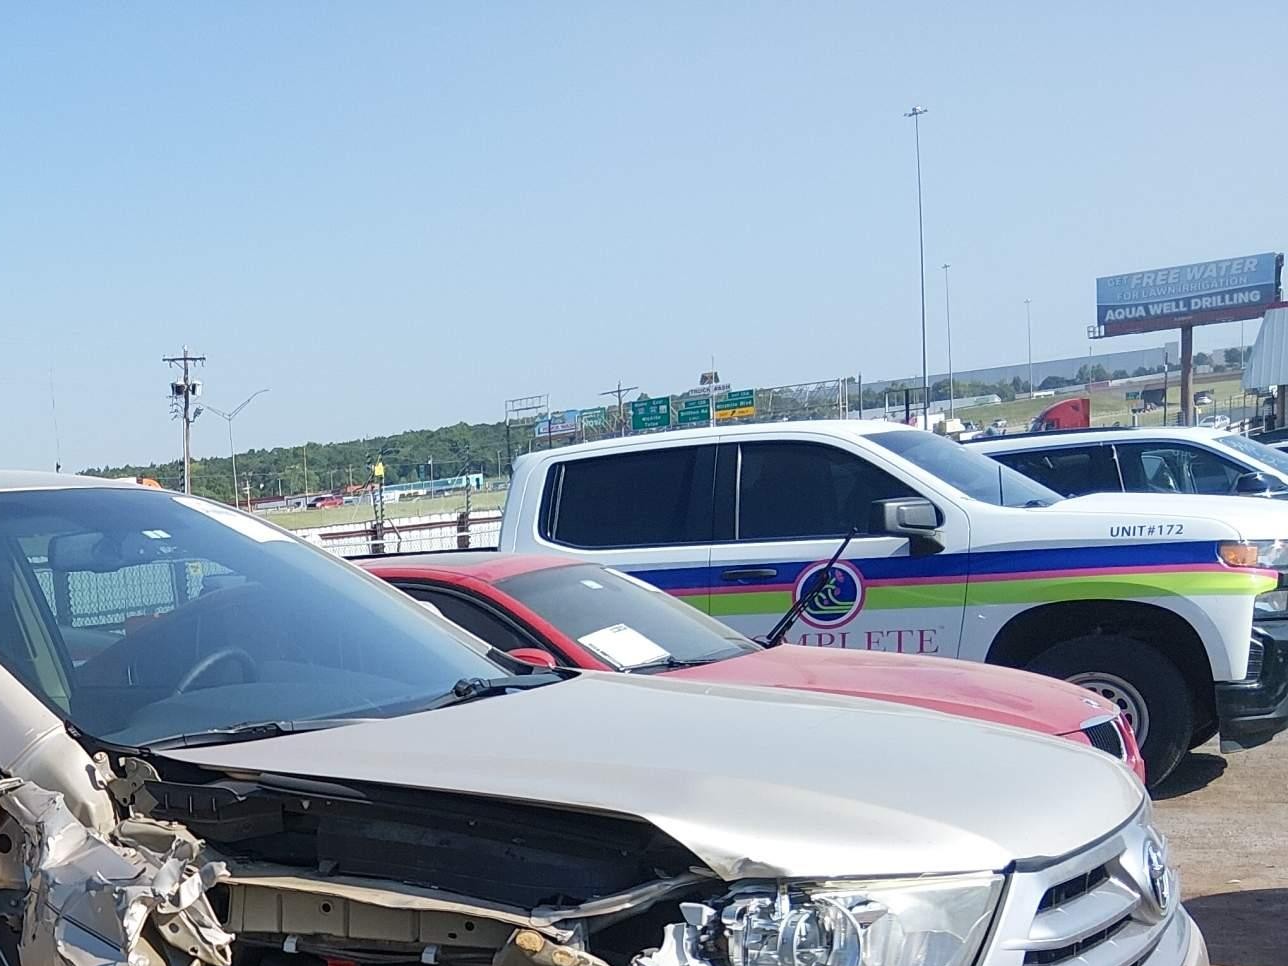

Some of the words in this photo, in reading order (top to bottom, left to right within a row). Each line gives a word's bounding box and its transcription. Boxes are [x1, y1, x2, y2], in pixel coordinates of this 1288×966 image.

[1131, 269, 1180, 288] FREE
[1186, 258, 1258, 281] WATER
[1117, 289, 1139, 301] FOR
[1142, 285, 1175, 298] LAWN
[1177, 276, 1249, 293] IRRIGATION
[1105, 305, 1147, 321] AQUA
[1148, 300, 1187, 316] WELL
[1191, 290, 1261, 310] DRILLING
[1110, 524, 1184, 537] UNIT#172
